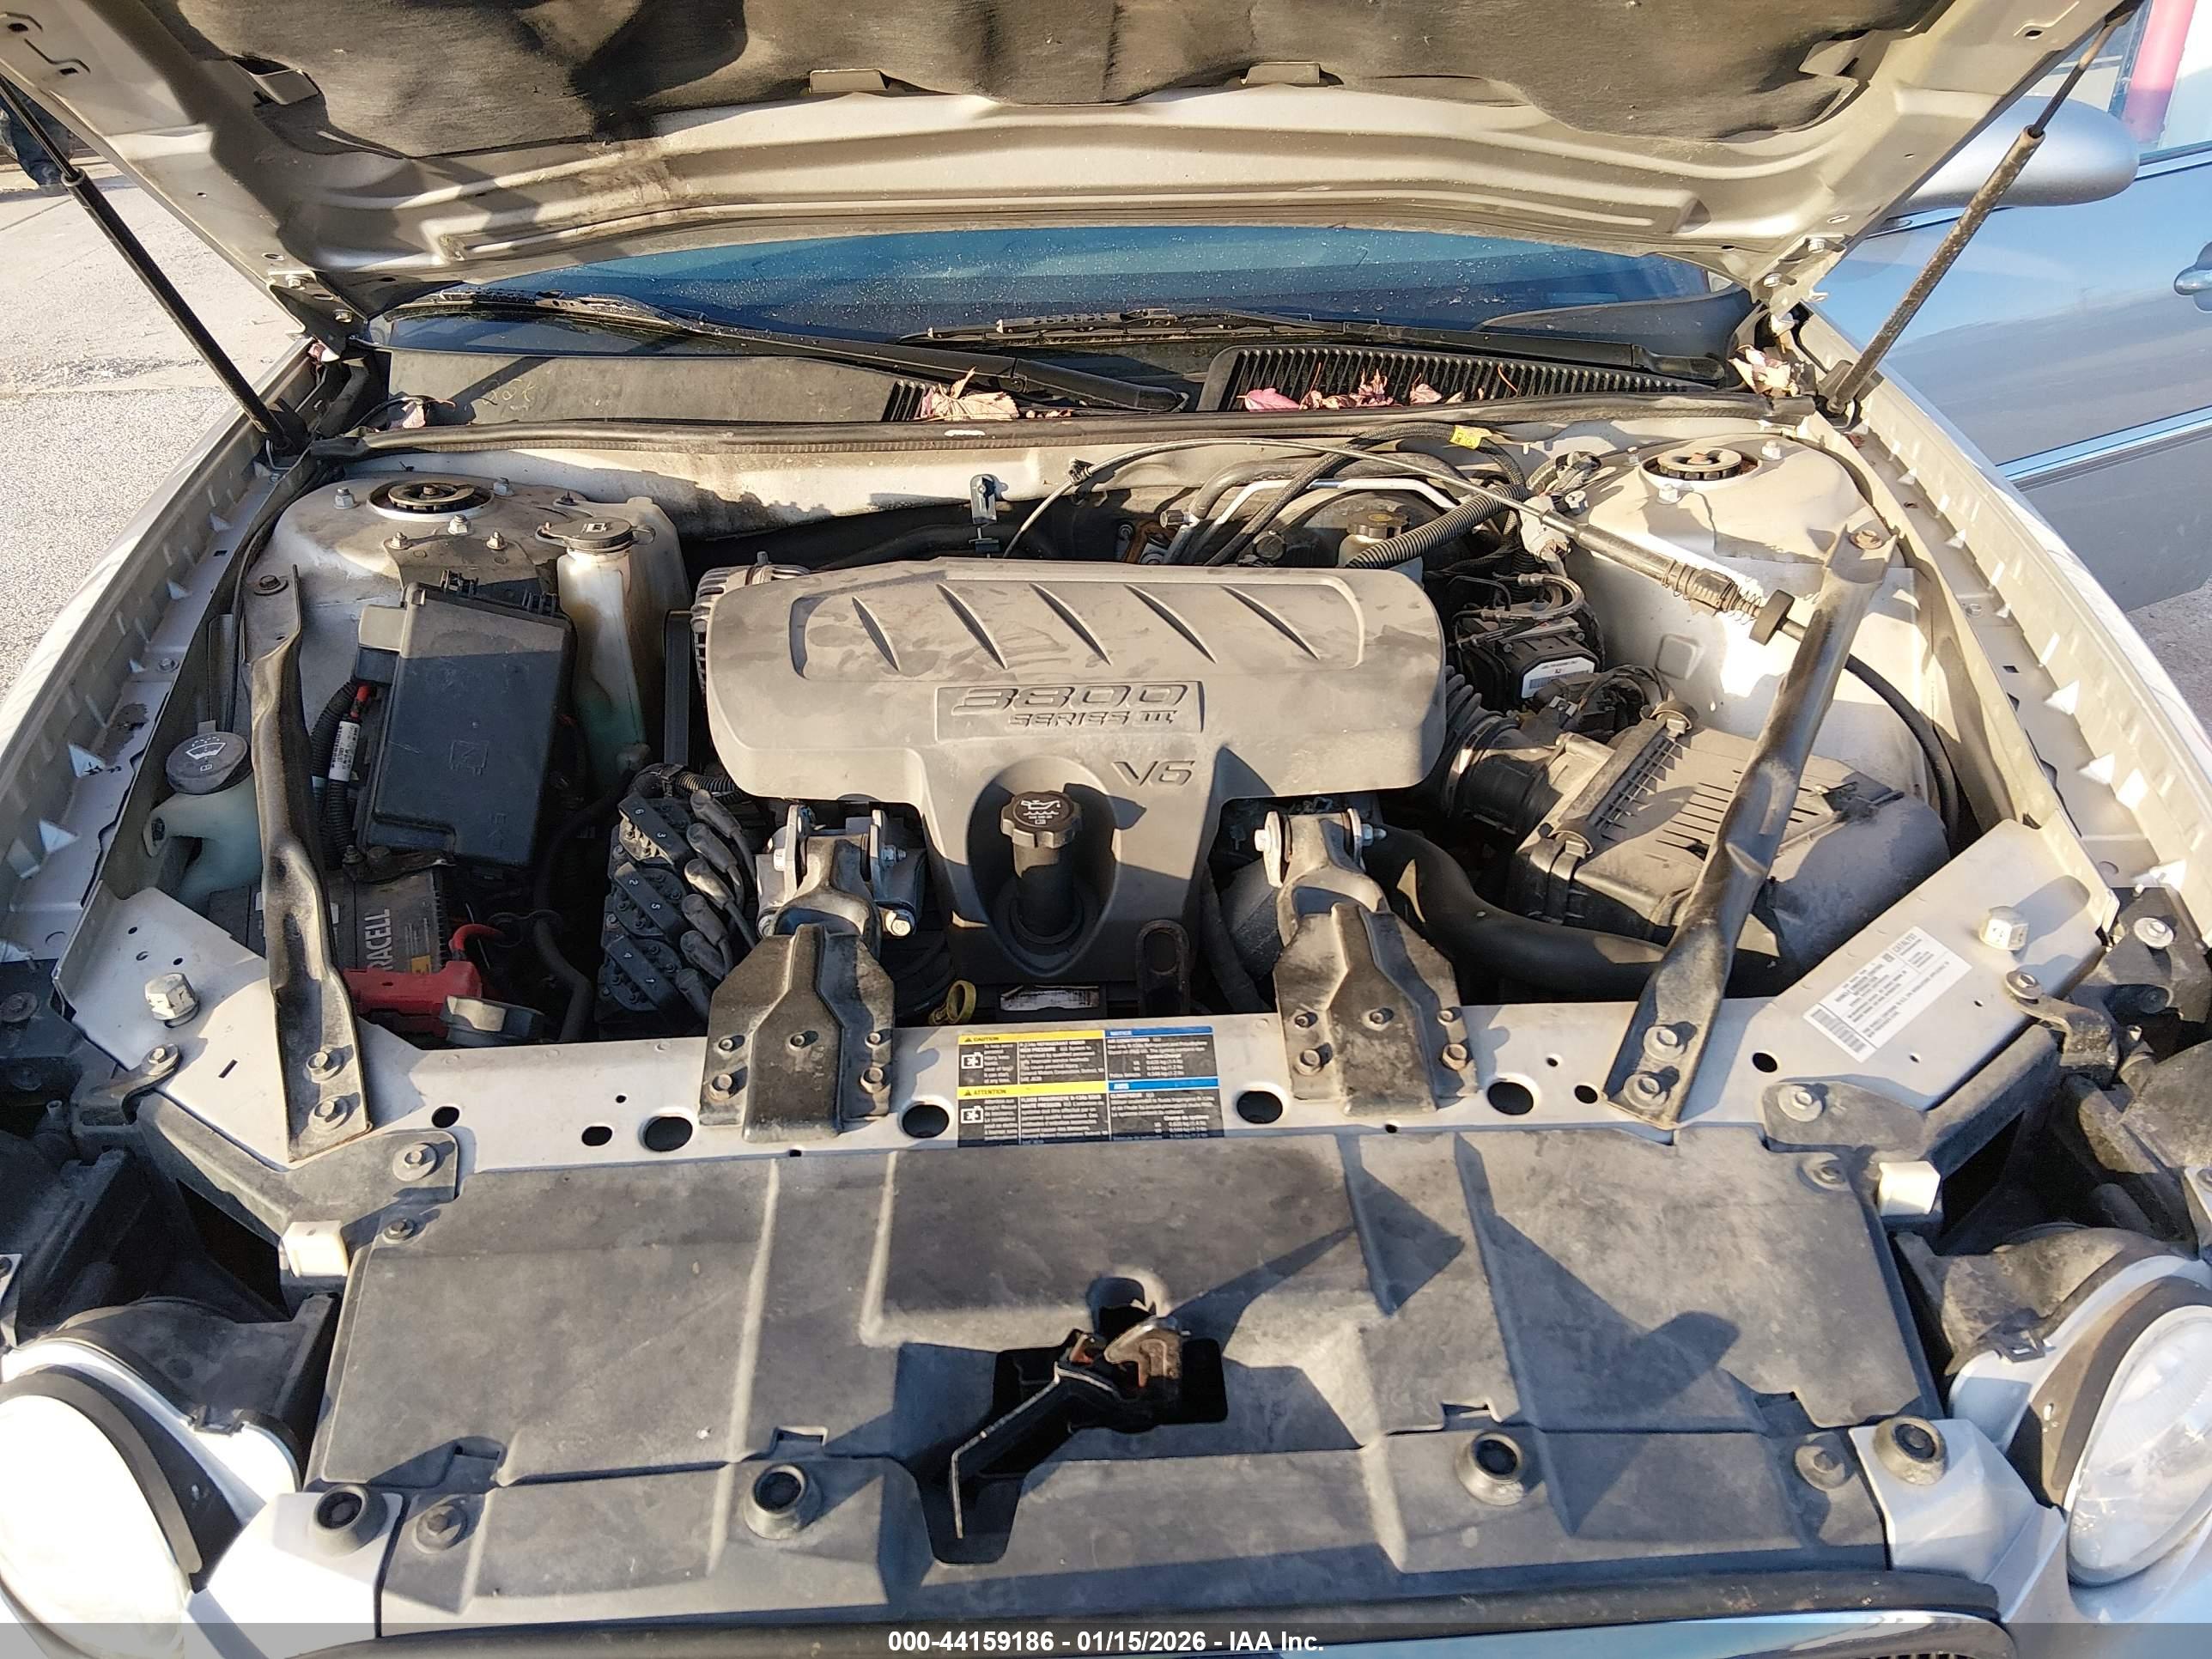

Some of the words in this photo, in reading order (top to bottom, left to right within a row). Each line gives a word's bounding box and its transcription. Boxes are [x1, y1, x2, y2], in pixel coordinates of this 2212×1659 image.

[951, 684, 1188, 716] 3800
[1008, 710, 1131, 728] SERIES
[1112, 760, 1195, 787] V6
